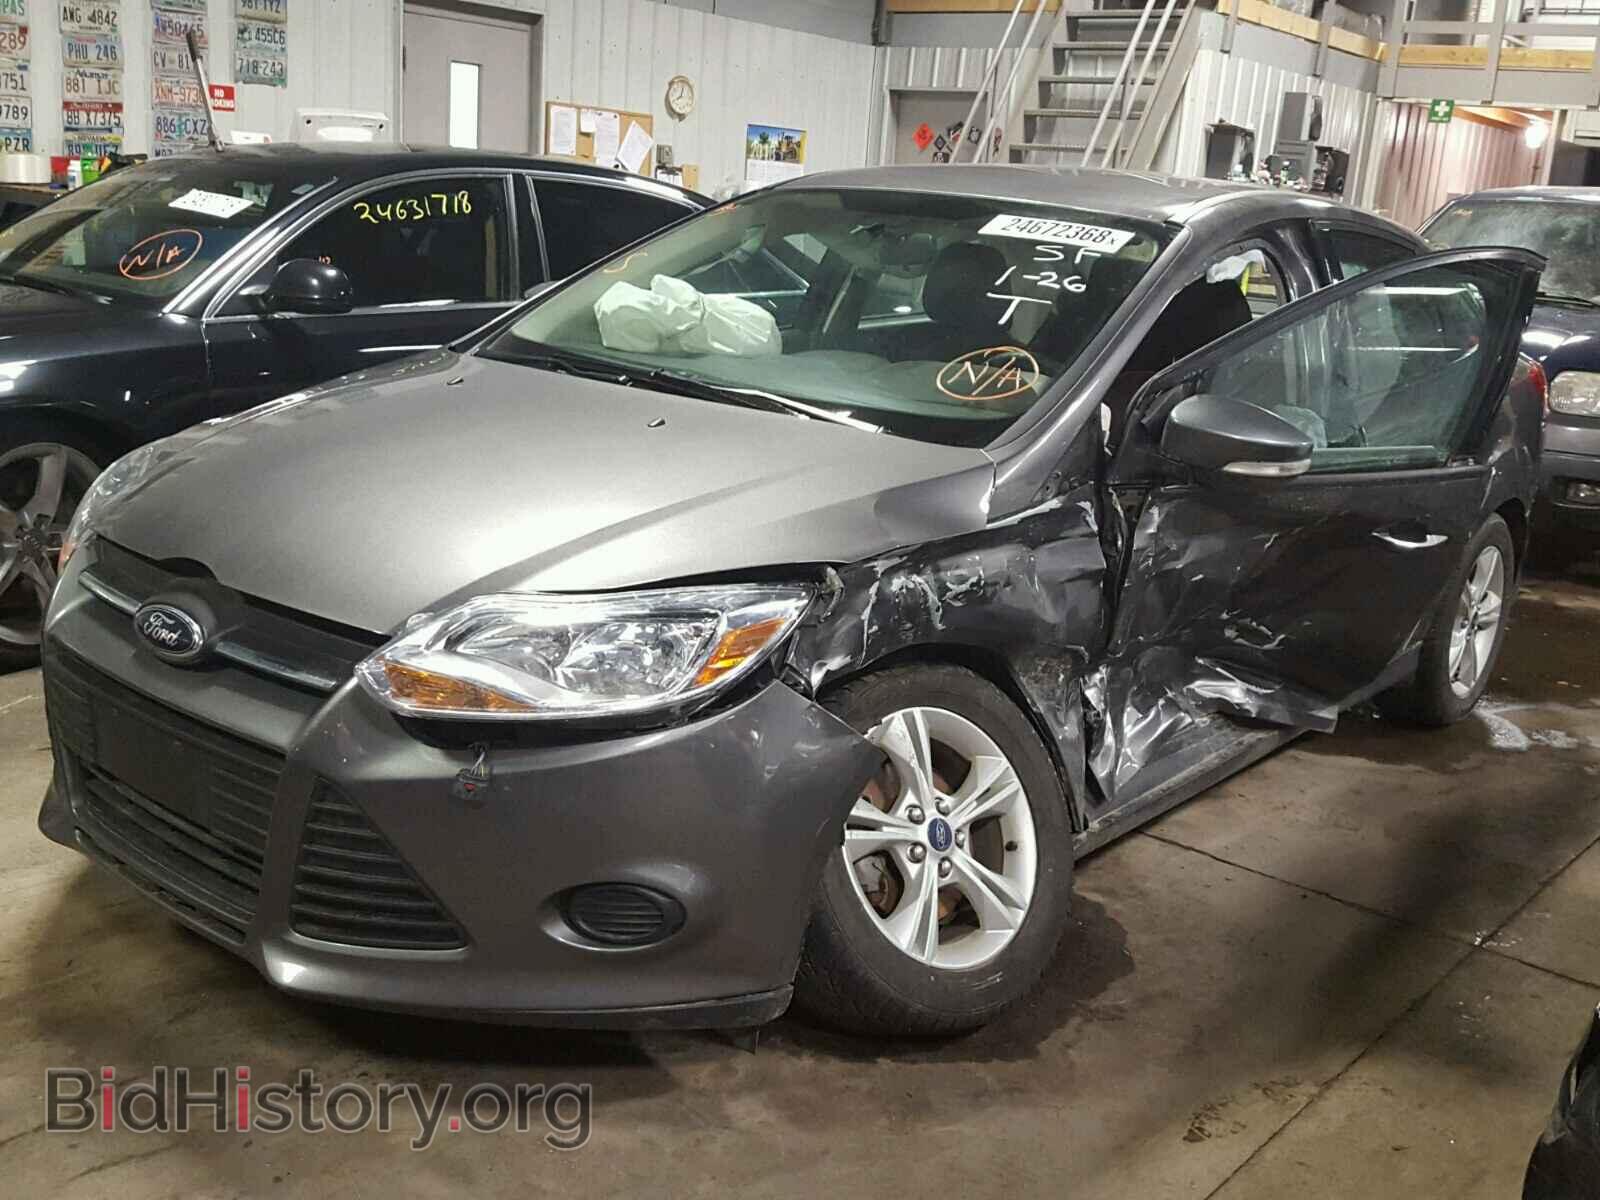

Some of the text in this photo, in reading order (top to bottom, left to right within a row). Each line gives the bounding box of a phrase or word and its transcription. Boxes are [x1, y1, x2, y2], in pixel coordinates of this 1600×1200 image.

[0, 72, 26, 91] 751
[353, 190, 472, 223] 24631718
[947, 356, 1022, 396] N/A
[143, 611, 182, 647] Ford
